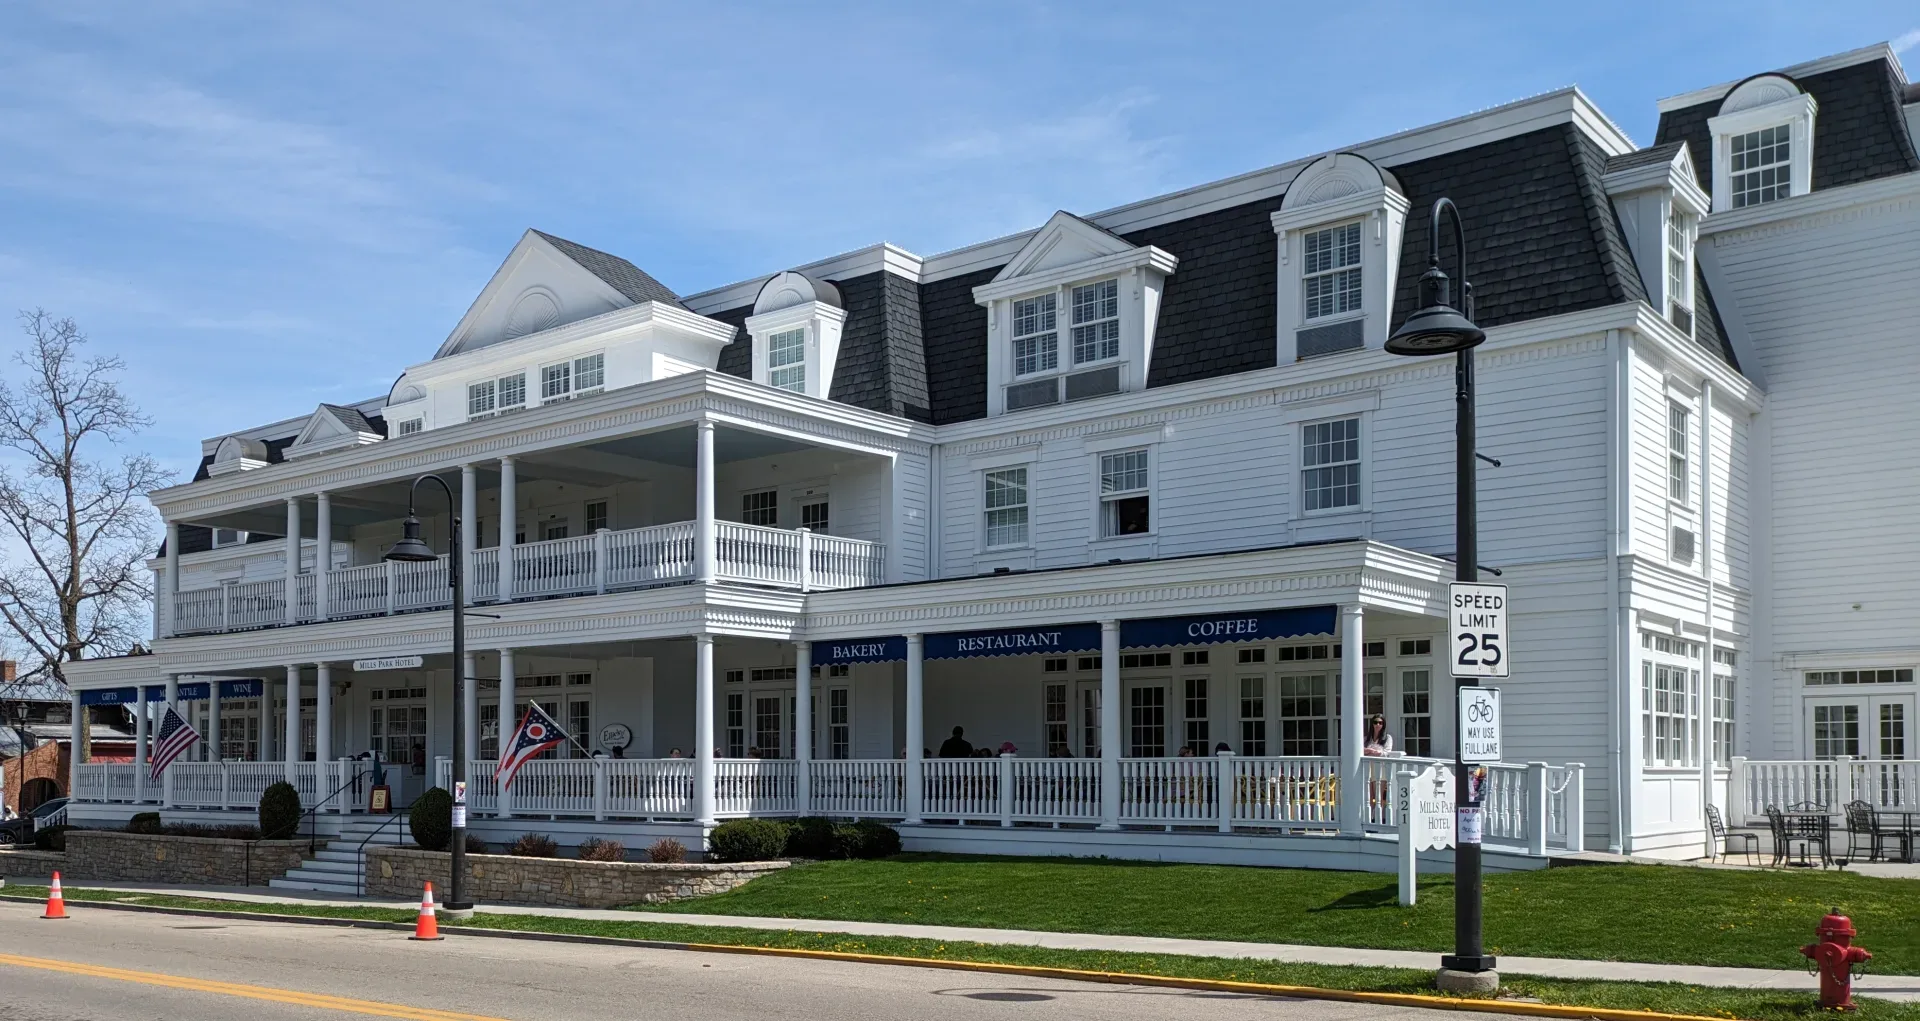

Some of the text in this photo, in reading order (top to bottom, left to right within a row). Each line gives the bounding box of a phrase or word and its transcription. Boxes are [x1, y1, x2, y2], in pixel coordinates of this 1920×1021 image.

[1454, 594, 1503, 609] SPEED
[1187, 618, 1259, 637] COFFEE
[1460, 613, 1497, 628] LIMIT
[957, 632, 1062, 651] RESTAURANT
[832, 643, 886, 659] BAKERY
[1457, 632, 1502, 667] 25
[360, 658, 415, 670] MILLS PARK HOTEL
[233, 683, 252, 693] WINE
[101, 691, 118, 701] GIFTS
[1467, 727, 1495, 739] MAY USE
[1465, 742, 1498, 754] FULL LANE
[1419, 800, 1440, 813] MILLS
[1428, 816, 1451, 830] HOTEL
